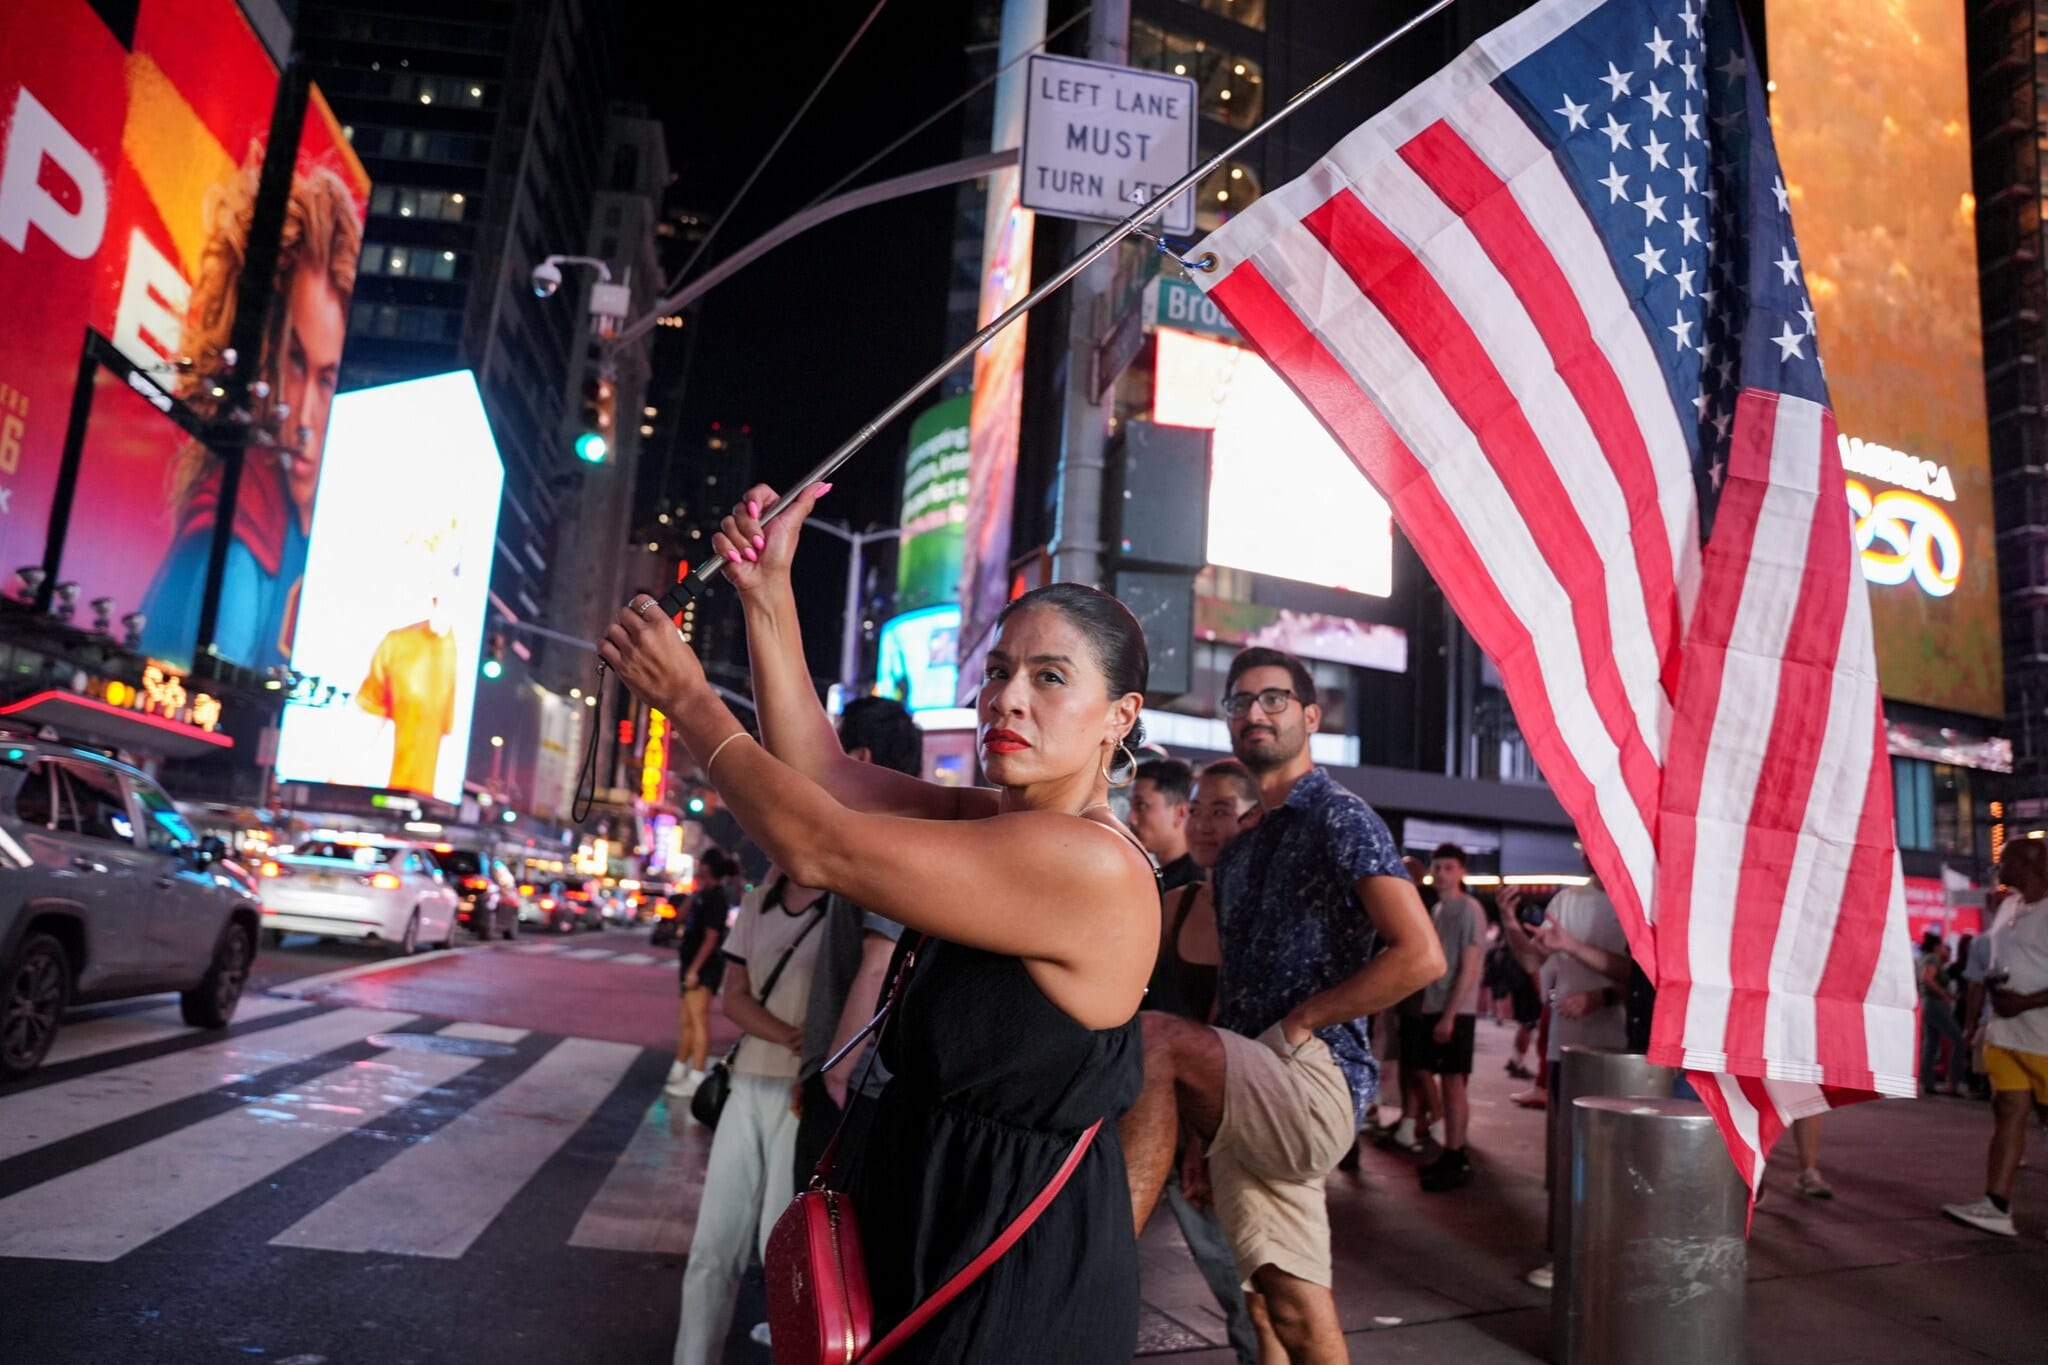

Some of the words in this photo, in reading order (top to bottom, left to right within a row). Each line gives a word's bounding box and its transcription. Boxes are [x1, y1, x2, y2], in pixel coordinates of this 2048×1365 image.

[1042, 77, 1101, 107] LEFT
[1115, 88, 1180, 120] LANE
[1066, 122, 1152, 162] MUST
[1037, 166, 1104, 199] TURN
